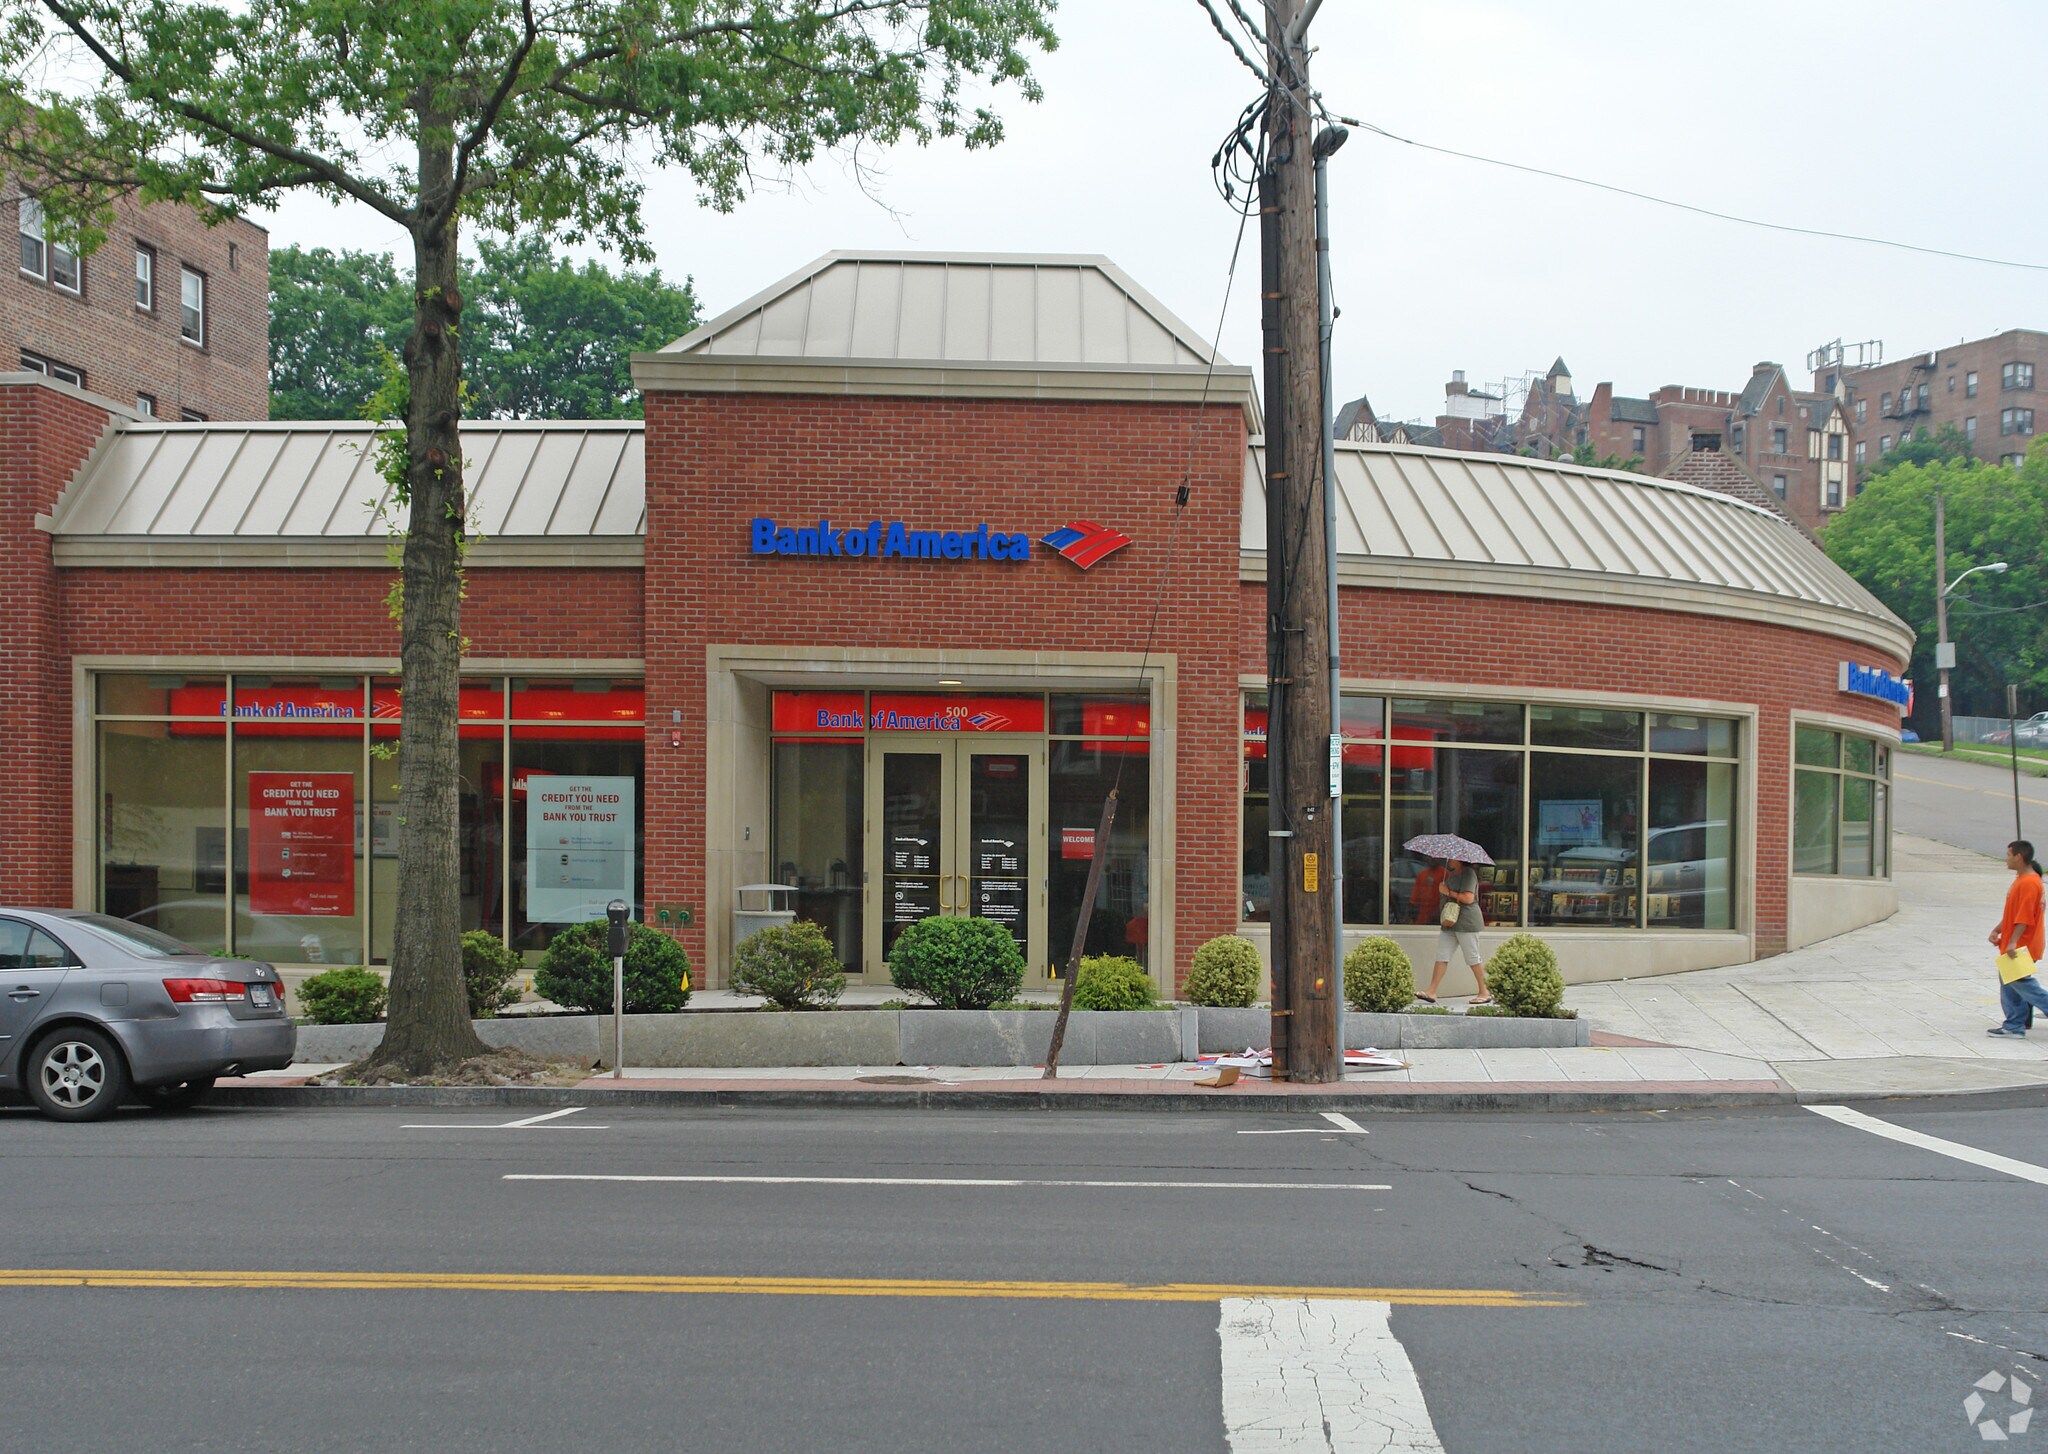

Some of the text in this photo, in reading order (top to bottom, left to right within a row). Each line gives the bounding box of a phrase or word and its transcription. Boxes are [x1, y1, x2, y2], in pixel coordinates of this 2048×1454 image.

[752, 518, 1030, 560] Bank of America
[265, 702, 283, 717] of
[285, 702, 354, 718] America
[946, 706, 968, 718] 500
[817, 709, 863, 727] Bank
[886, 711, 961, 731] America
[263, 789, 340, 799] CREDIT YOU NEED
[541, 794, 620, 803] CREDIT YOU NEED
[265, 808, 336, 817] BANK YOU TRUST
[543, 812, 616, 822] BANK YOU TRUST
